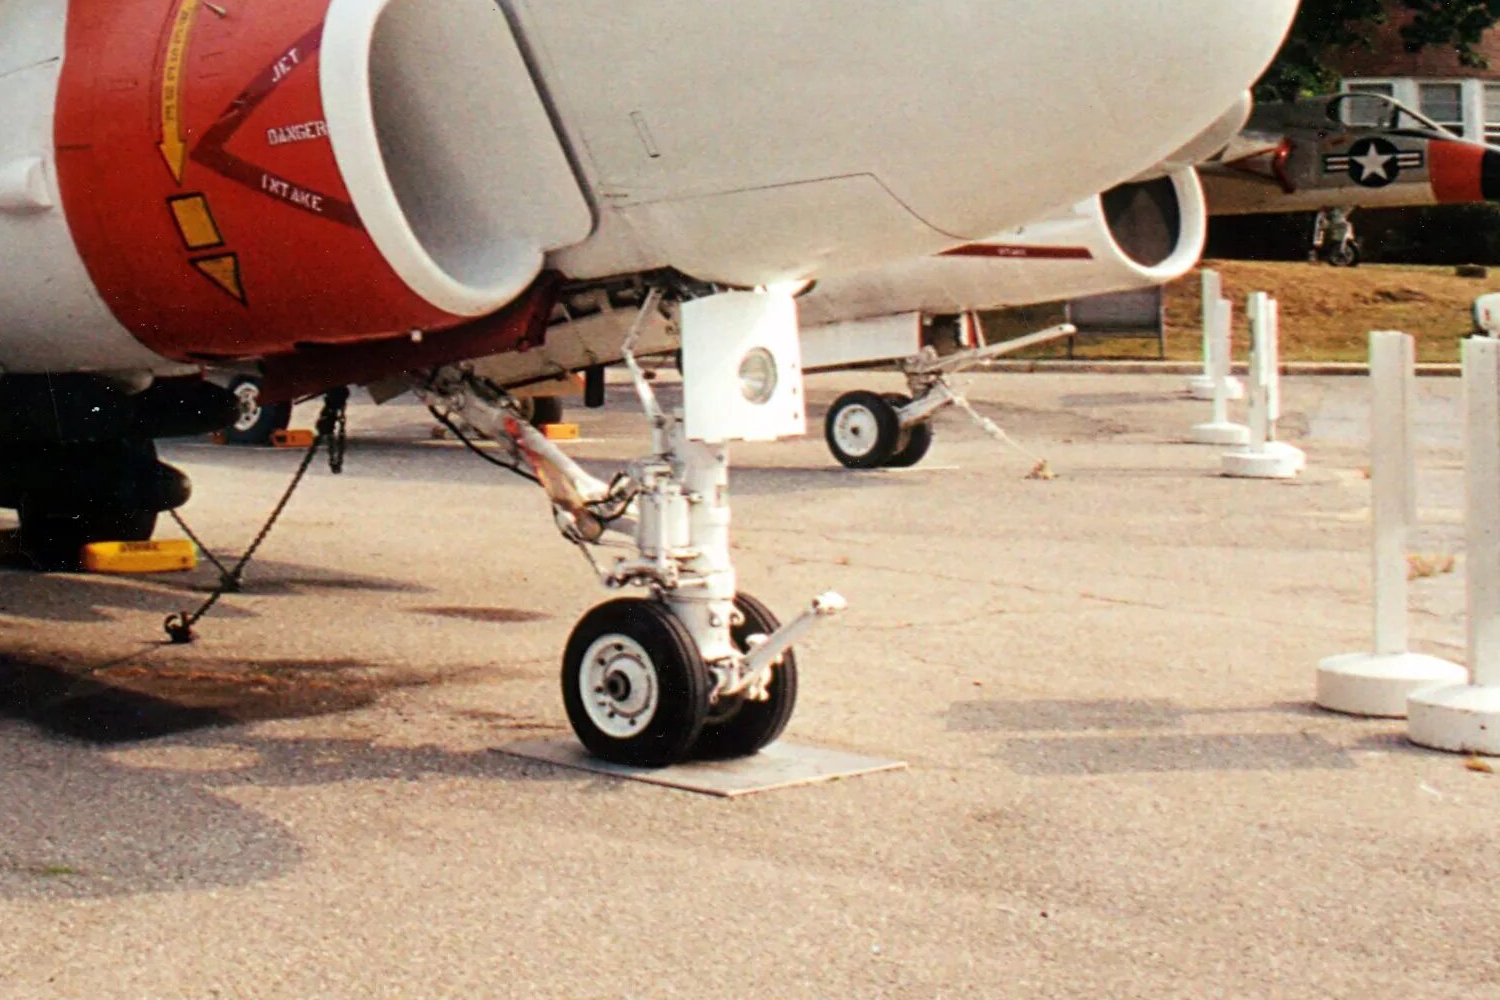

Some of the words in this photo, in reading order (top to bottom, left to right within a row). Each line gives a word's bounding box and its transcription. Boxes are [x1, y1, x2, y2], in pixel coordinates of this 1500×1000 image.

[271, 48, 300, 82] JET
[267, 120, 328, 146] DANGER
[261, 174, 323, 212] INTAKE
